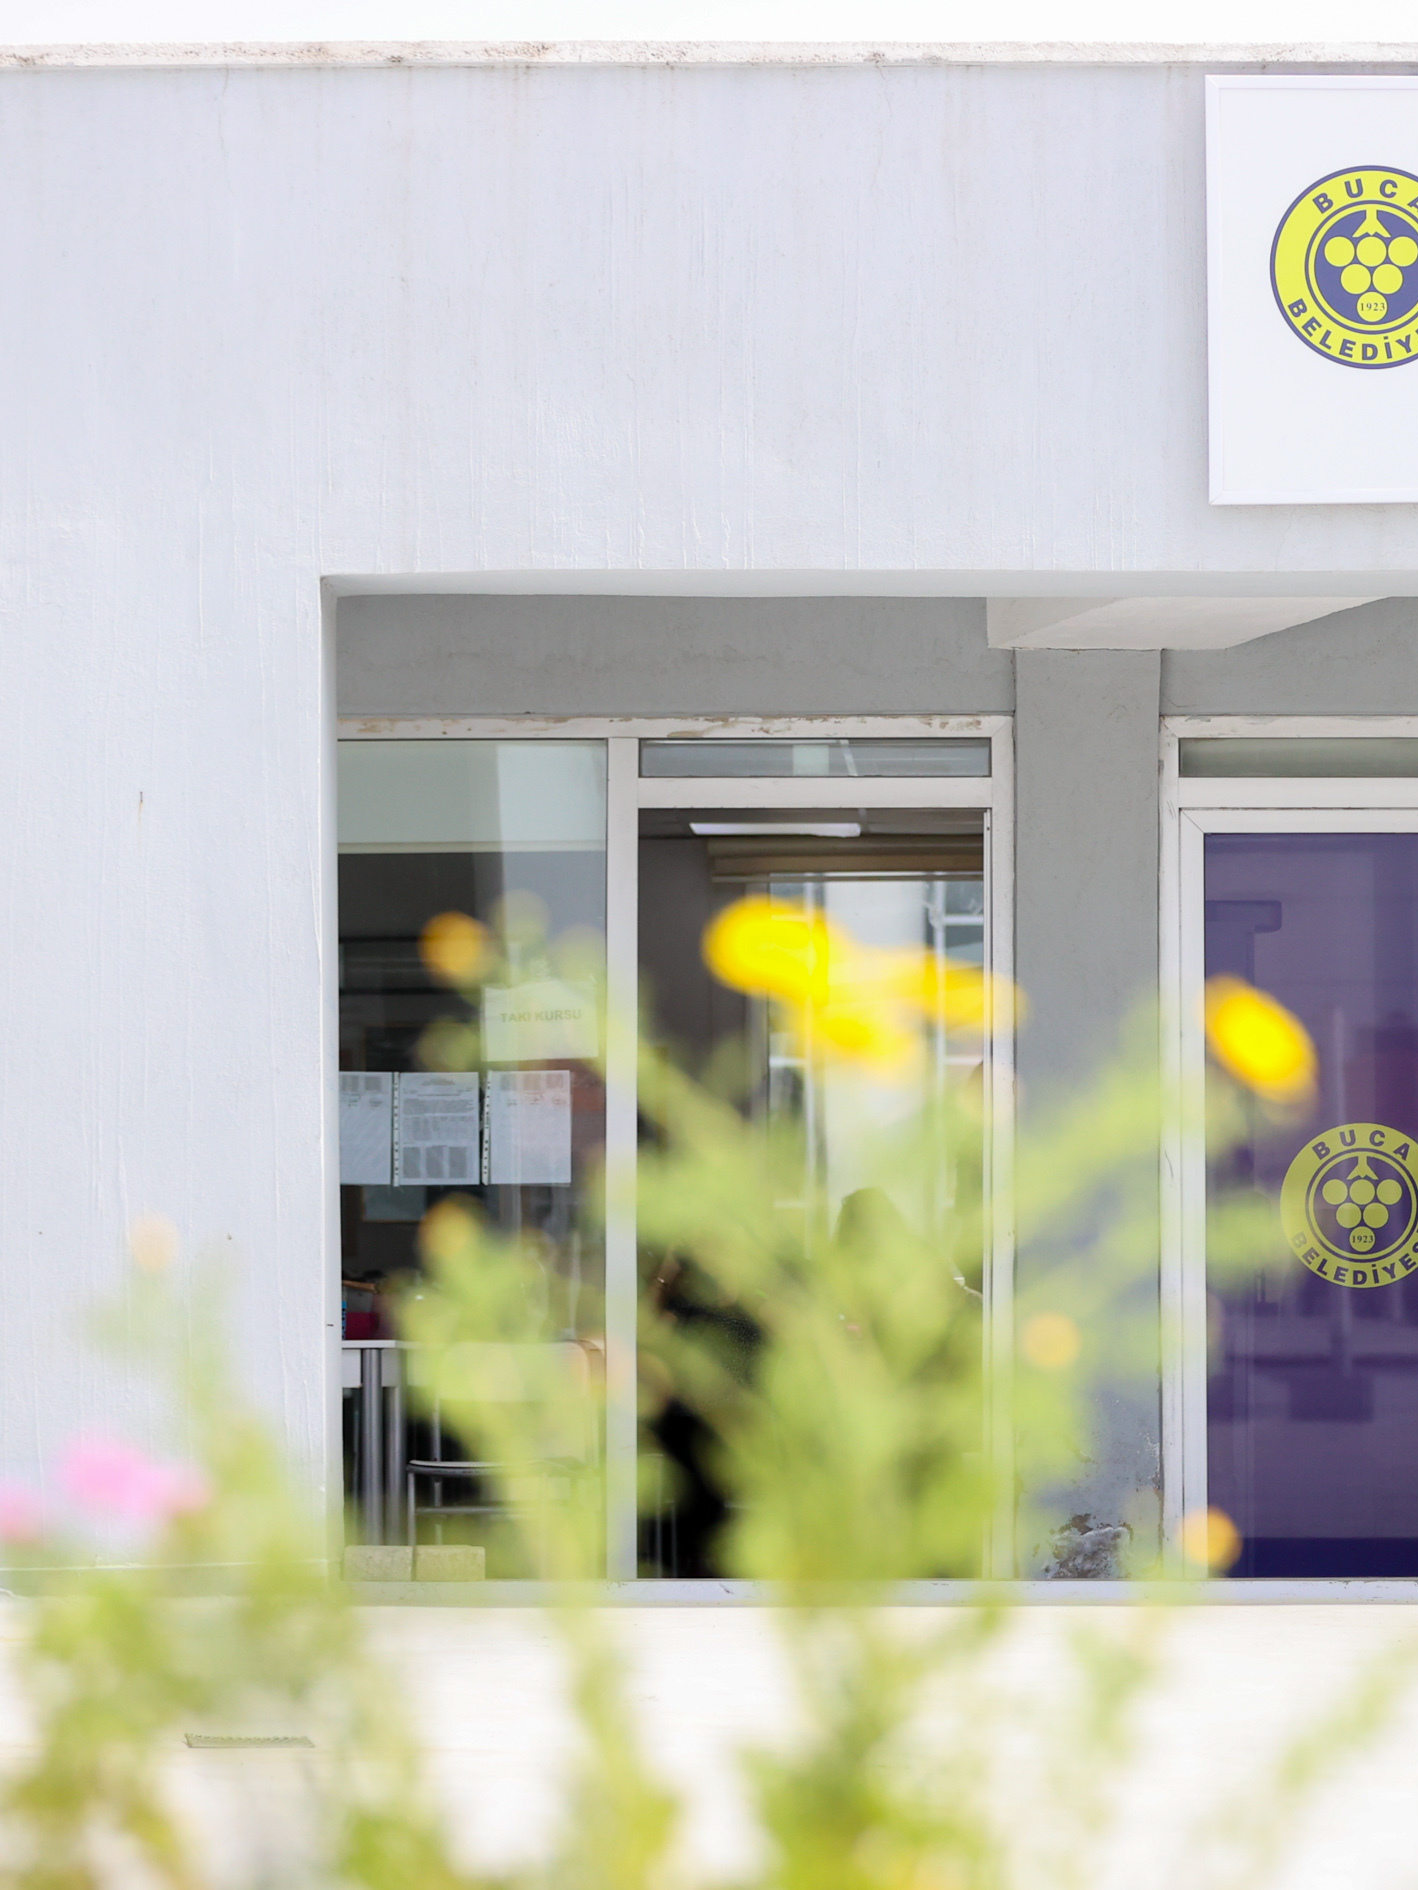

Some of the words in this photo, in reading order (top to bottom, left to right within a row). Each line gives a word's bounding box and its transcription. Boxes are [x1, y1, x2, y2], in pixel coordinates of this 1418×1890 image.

[1359, 302, 1386, 312] 1923
[535, 1009, 583, 1021] KURSU
[1312, 1129, 1411, 1161] BUCA
[1351, 1234, 1375, 1244] 1923
